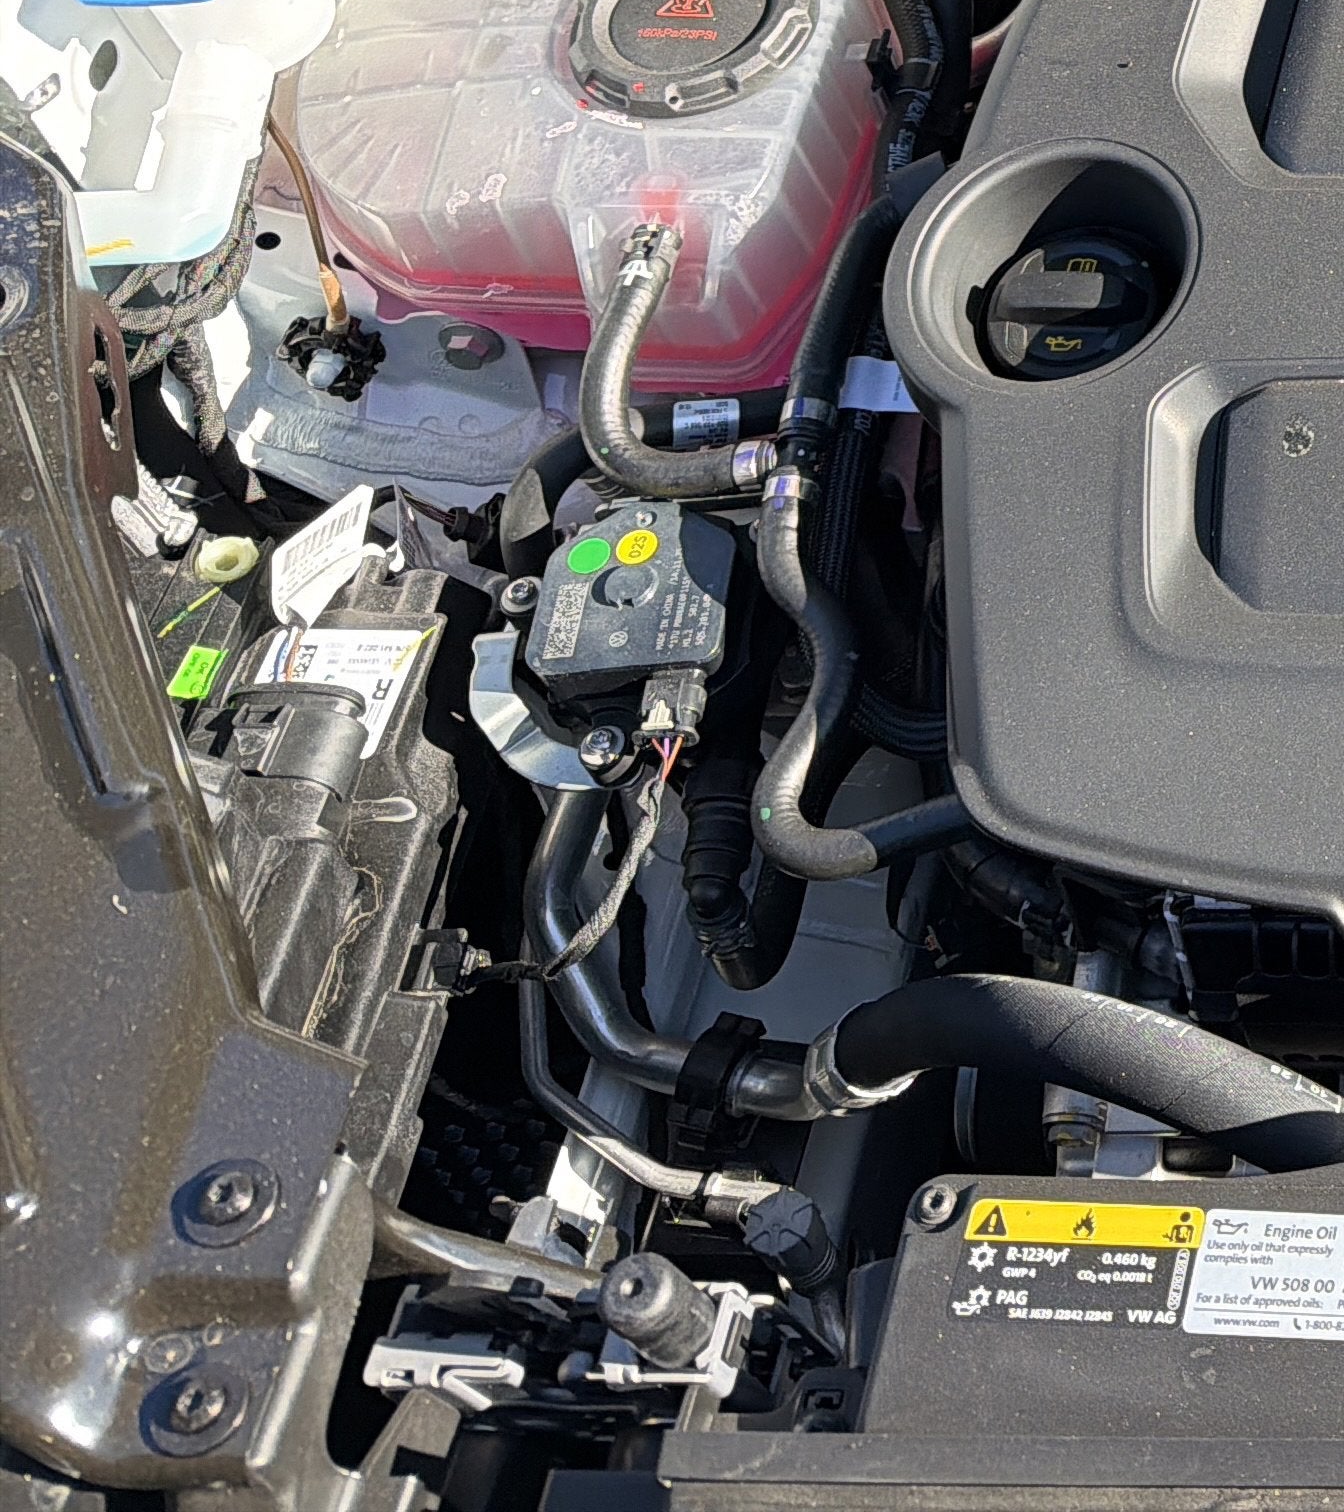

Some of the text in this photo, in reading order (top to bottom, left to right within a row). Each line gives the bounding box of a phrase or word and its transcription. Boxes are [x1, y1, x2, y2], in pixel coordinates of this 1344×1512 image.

[1263, 1223, 1314, 1242] Engine
[1316, 1225, 1338, 1240] Oil
[1206, 1239, 1334, 1258] Use only oil that expressly
[1005, 1246, 1158, 1270] R-1234yf 0.460 kg
[1204, 1253, 1274, 1267] complies with
[1001, 1267, 1037, 1279] GWP 4
[1098, 1272, 1111, 1284] eq
[1250, 1275, 1279, 1290] VW
[1281, 1277, 1311, 1293] 508
[1313, 1278, 1336, 1294] 00
[995, 1289, 1029, 1306] PAG
[1195, 1292, 1213, 1304] For
[1213, 1295, 1221, 1304] a
[1222, 1293, 1239, 1305] list
[1239, 1294, 1253, 1305] of
[1252, 1295, 1300, 1309] approved
[1007, 1307, 1029, 1319] SAE
[1127, 1309, 1177, 1325] VW AG
